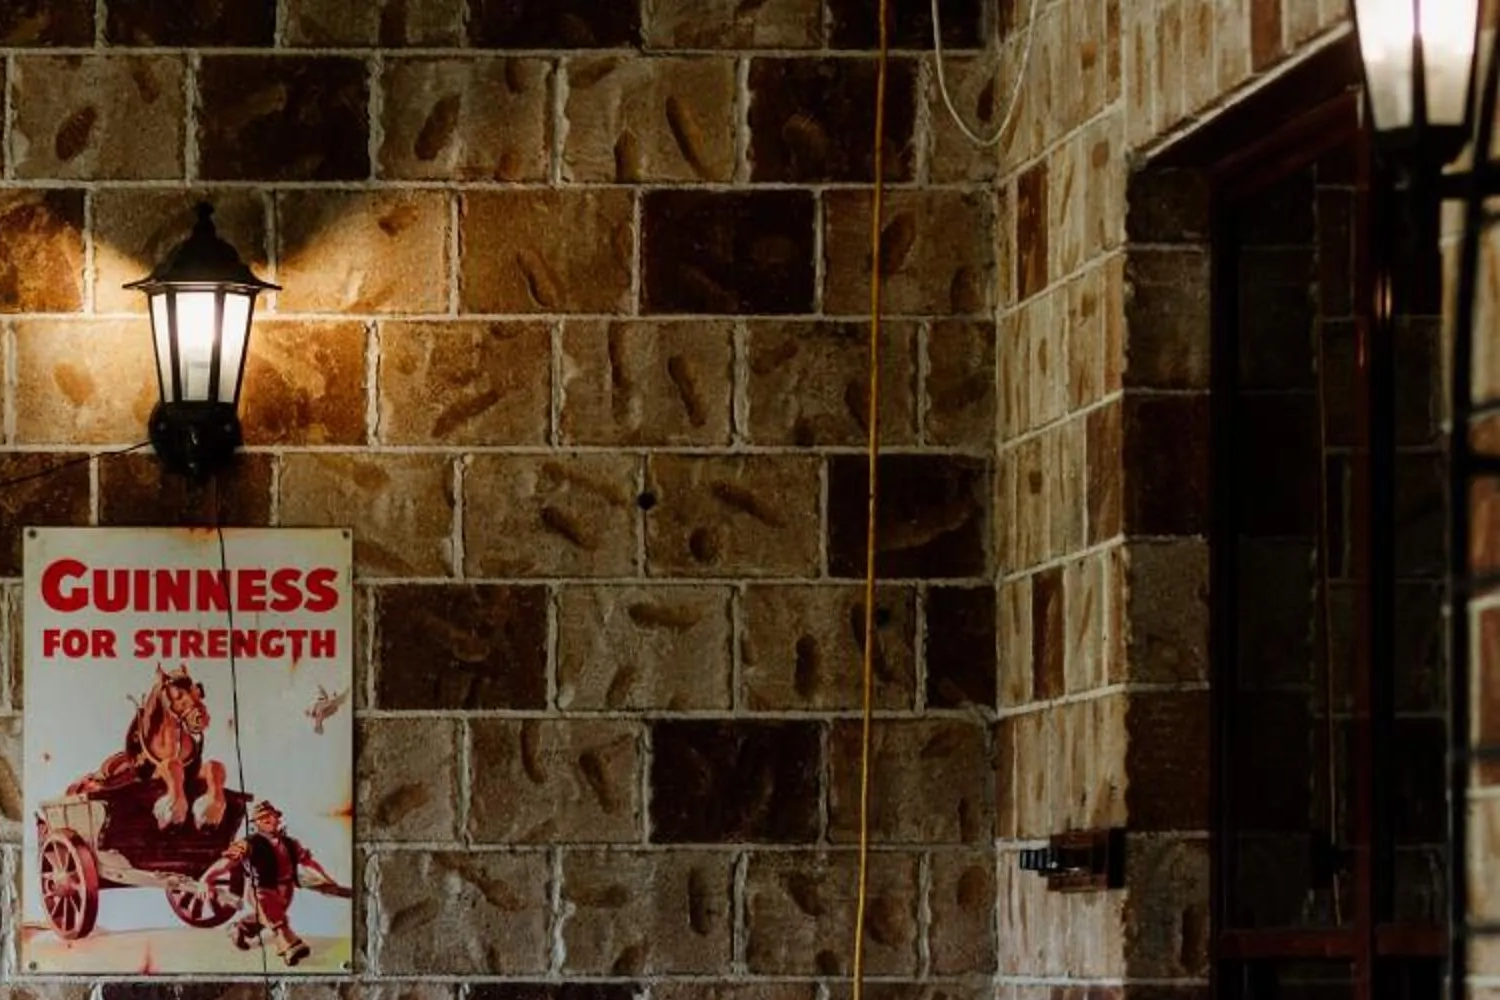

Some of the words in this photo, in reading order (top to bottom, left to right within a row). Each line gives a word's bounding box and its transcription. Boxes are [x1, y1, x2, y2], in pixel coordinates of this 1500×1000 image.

[41, 558, 339, 613] GUINNESS
[43, 629, 117, 658] FOR
[134, 629, 337, 659] STRENGTH
